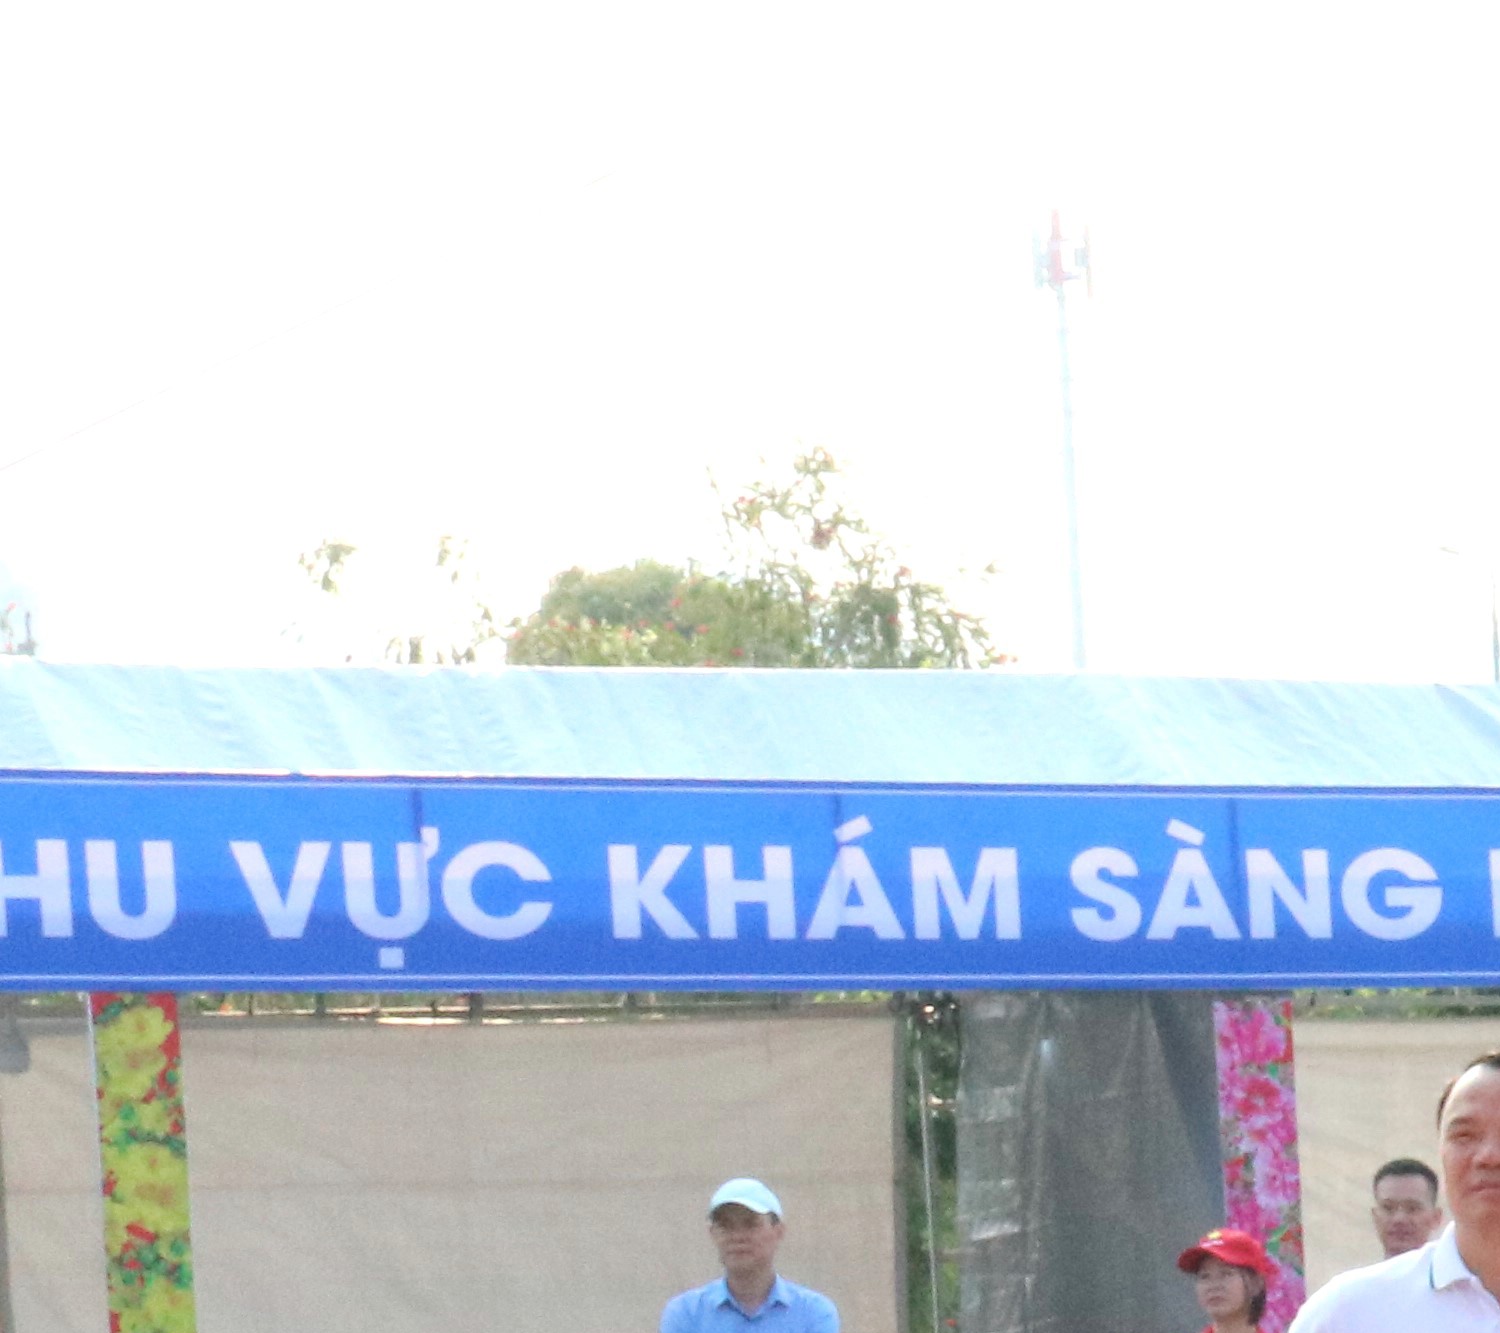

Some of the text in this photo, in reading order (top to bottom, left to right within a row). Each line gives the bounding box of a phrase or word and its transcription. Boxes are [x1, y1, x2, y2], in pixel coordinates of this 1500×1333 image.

[0, 838, 177, 939] HU
[228, 826, 553, 967] VỰC
[607, 815, 1021, 939] KHÁM
[1069, 818, 1443, 941] SÀNG
